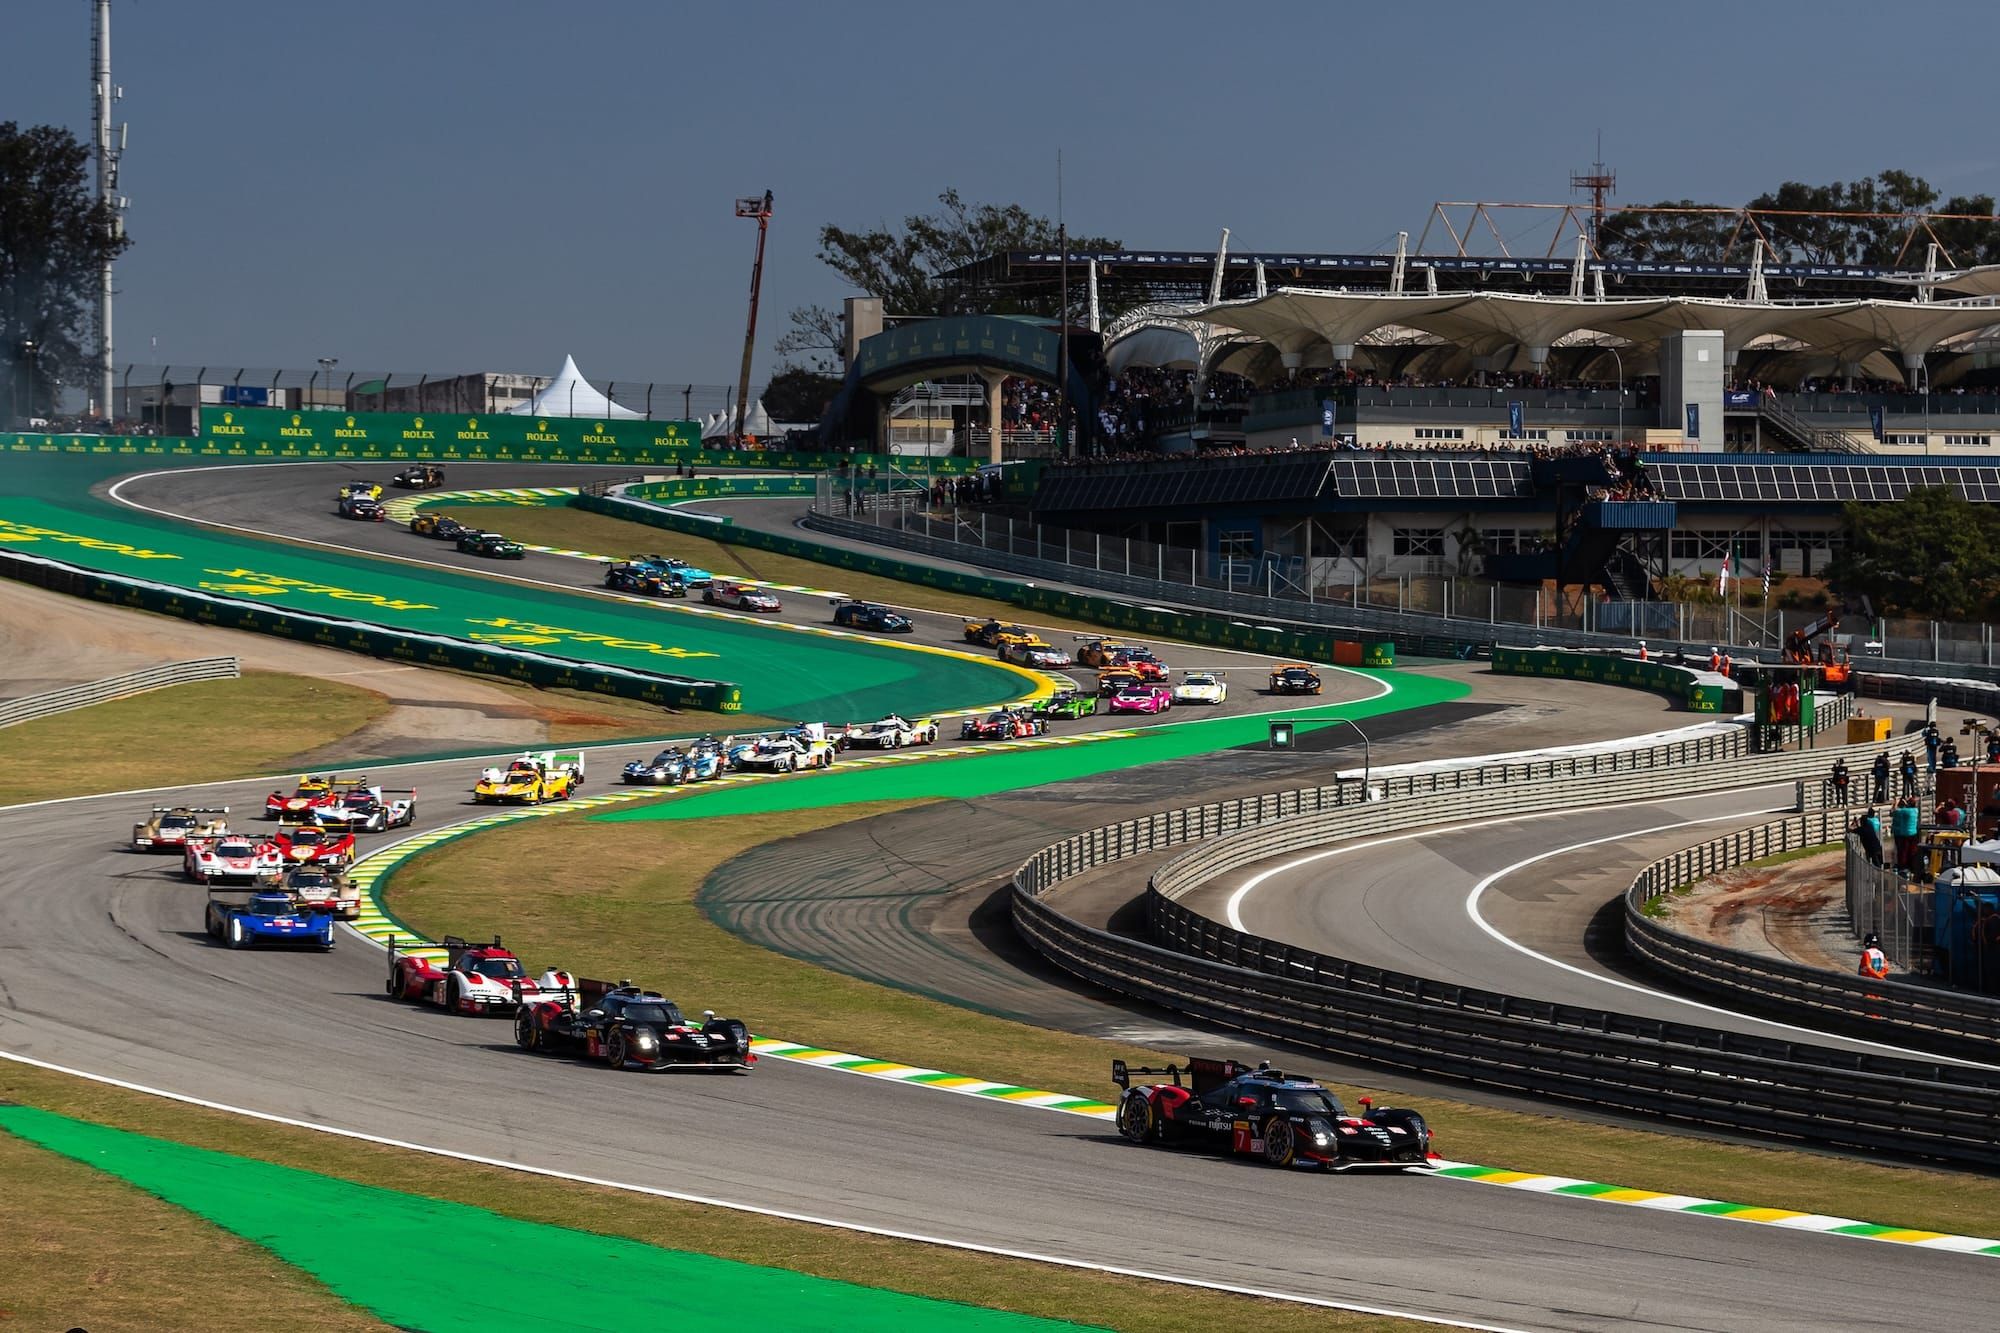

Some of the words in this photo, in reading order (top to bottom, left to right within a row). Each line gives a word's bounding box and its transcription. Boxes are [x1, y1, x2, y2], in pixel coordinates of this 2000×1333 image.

[212, 426, 244, 434] ROLEX
[280, 428, 312, 436] ROLEX
[335, 429, 367, 438] ROLEX
[403, 431, 434, 439] ROLEX
[526, 432, 559, 441] ROLEX
[582, 435, 616, 444] ROLEX
[655, 437, 688, 446] ROLEX
[0, 519, 184, 559] ROLE
[720, 702, 742, 710] ROLE
[1209, 1121, 1231, 1130] FUJITSU
[1238, 1131, 1245, 1148] 7
